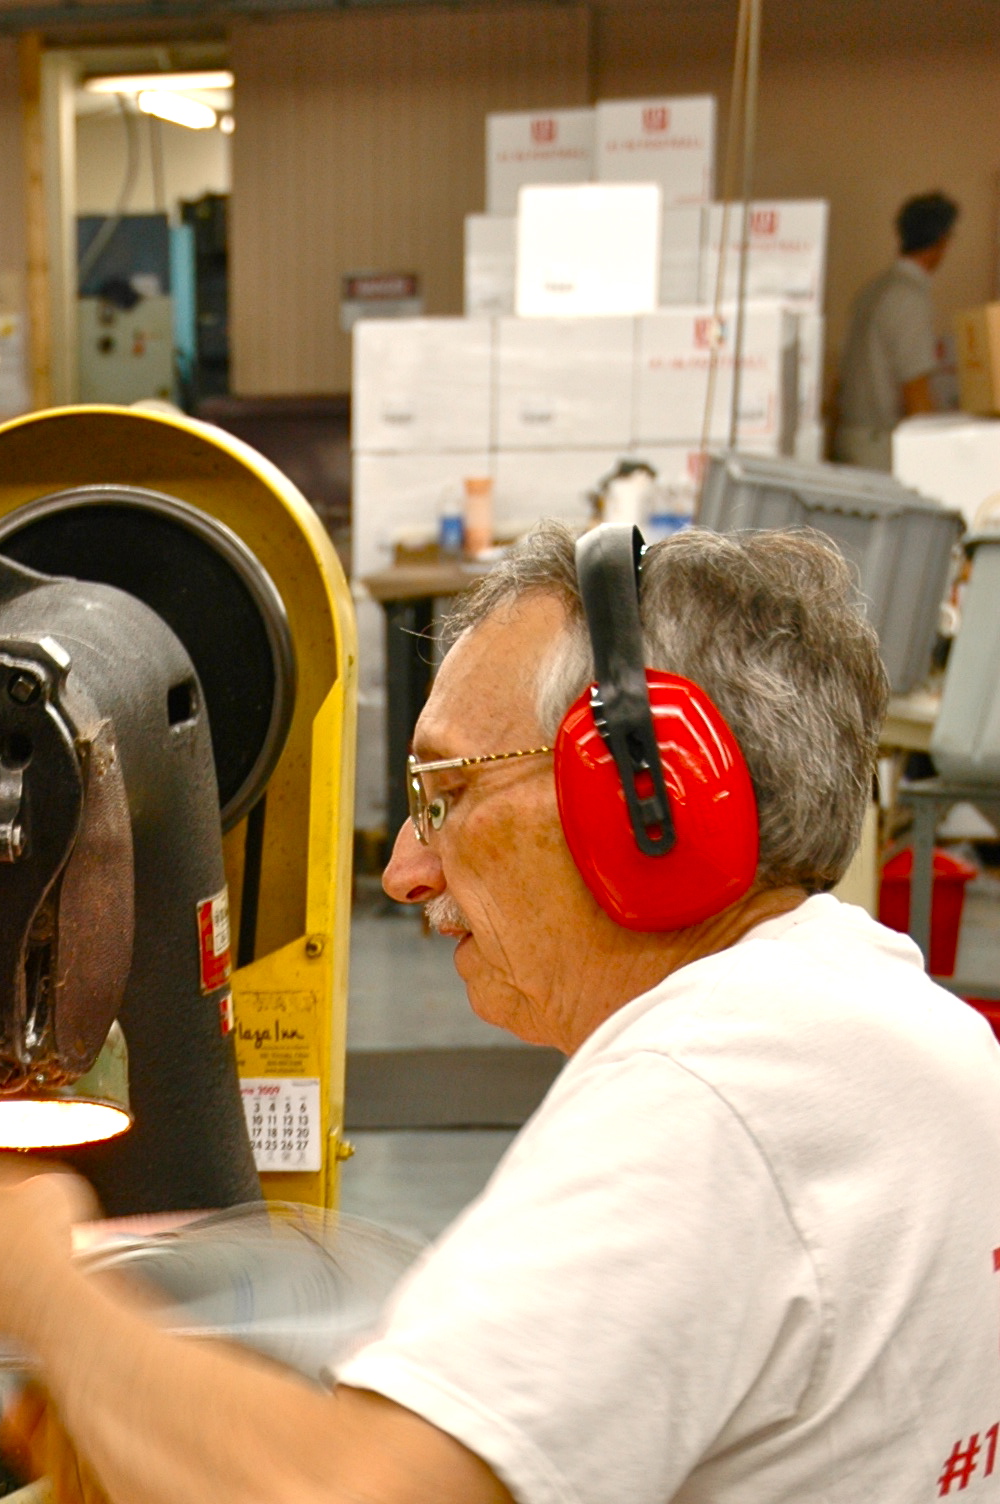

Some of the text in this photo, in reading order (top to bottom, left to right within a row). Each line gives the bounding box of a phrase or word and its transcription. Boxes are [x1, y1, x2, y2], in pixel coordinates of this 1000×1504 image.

[254, 1103, 306, 1113] 3 4 5 6
[253, 1115, 308, 1125] 10 11 12 13
[253, 1128, 309, 1138] 17 18 19 20
[265, 1140, 277, 1151] 25
[281, 1140, 293, 1151] 26
[297, 1140, 308, 1151] 27
